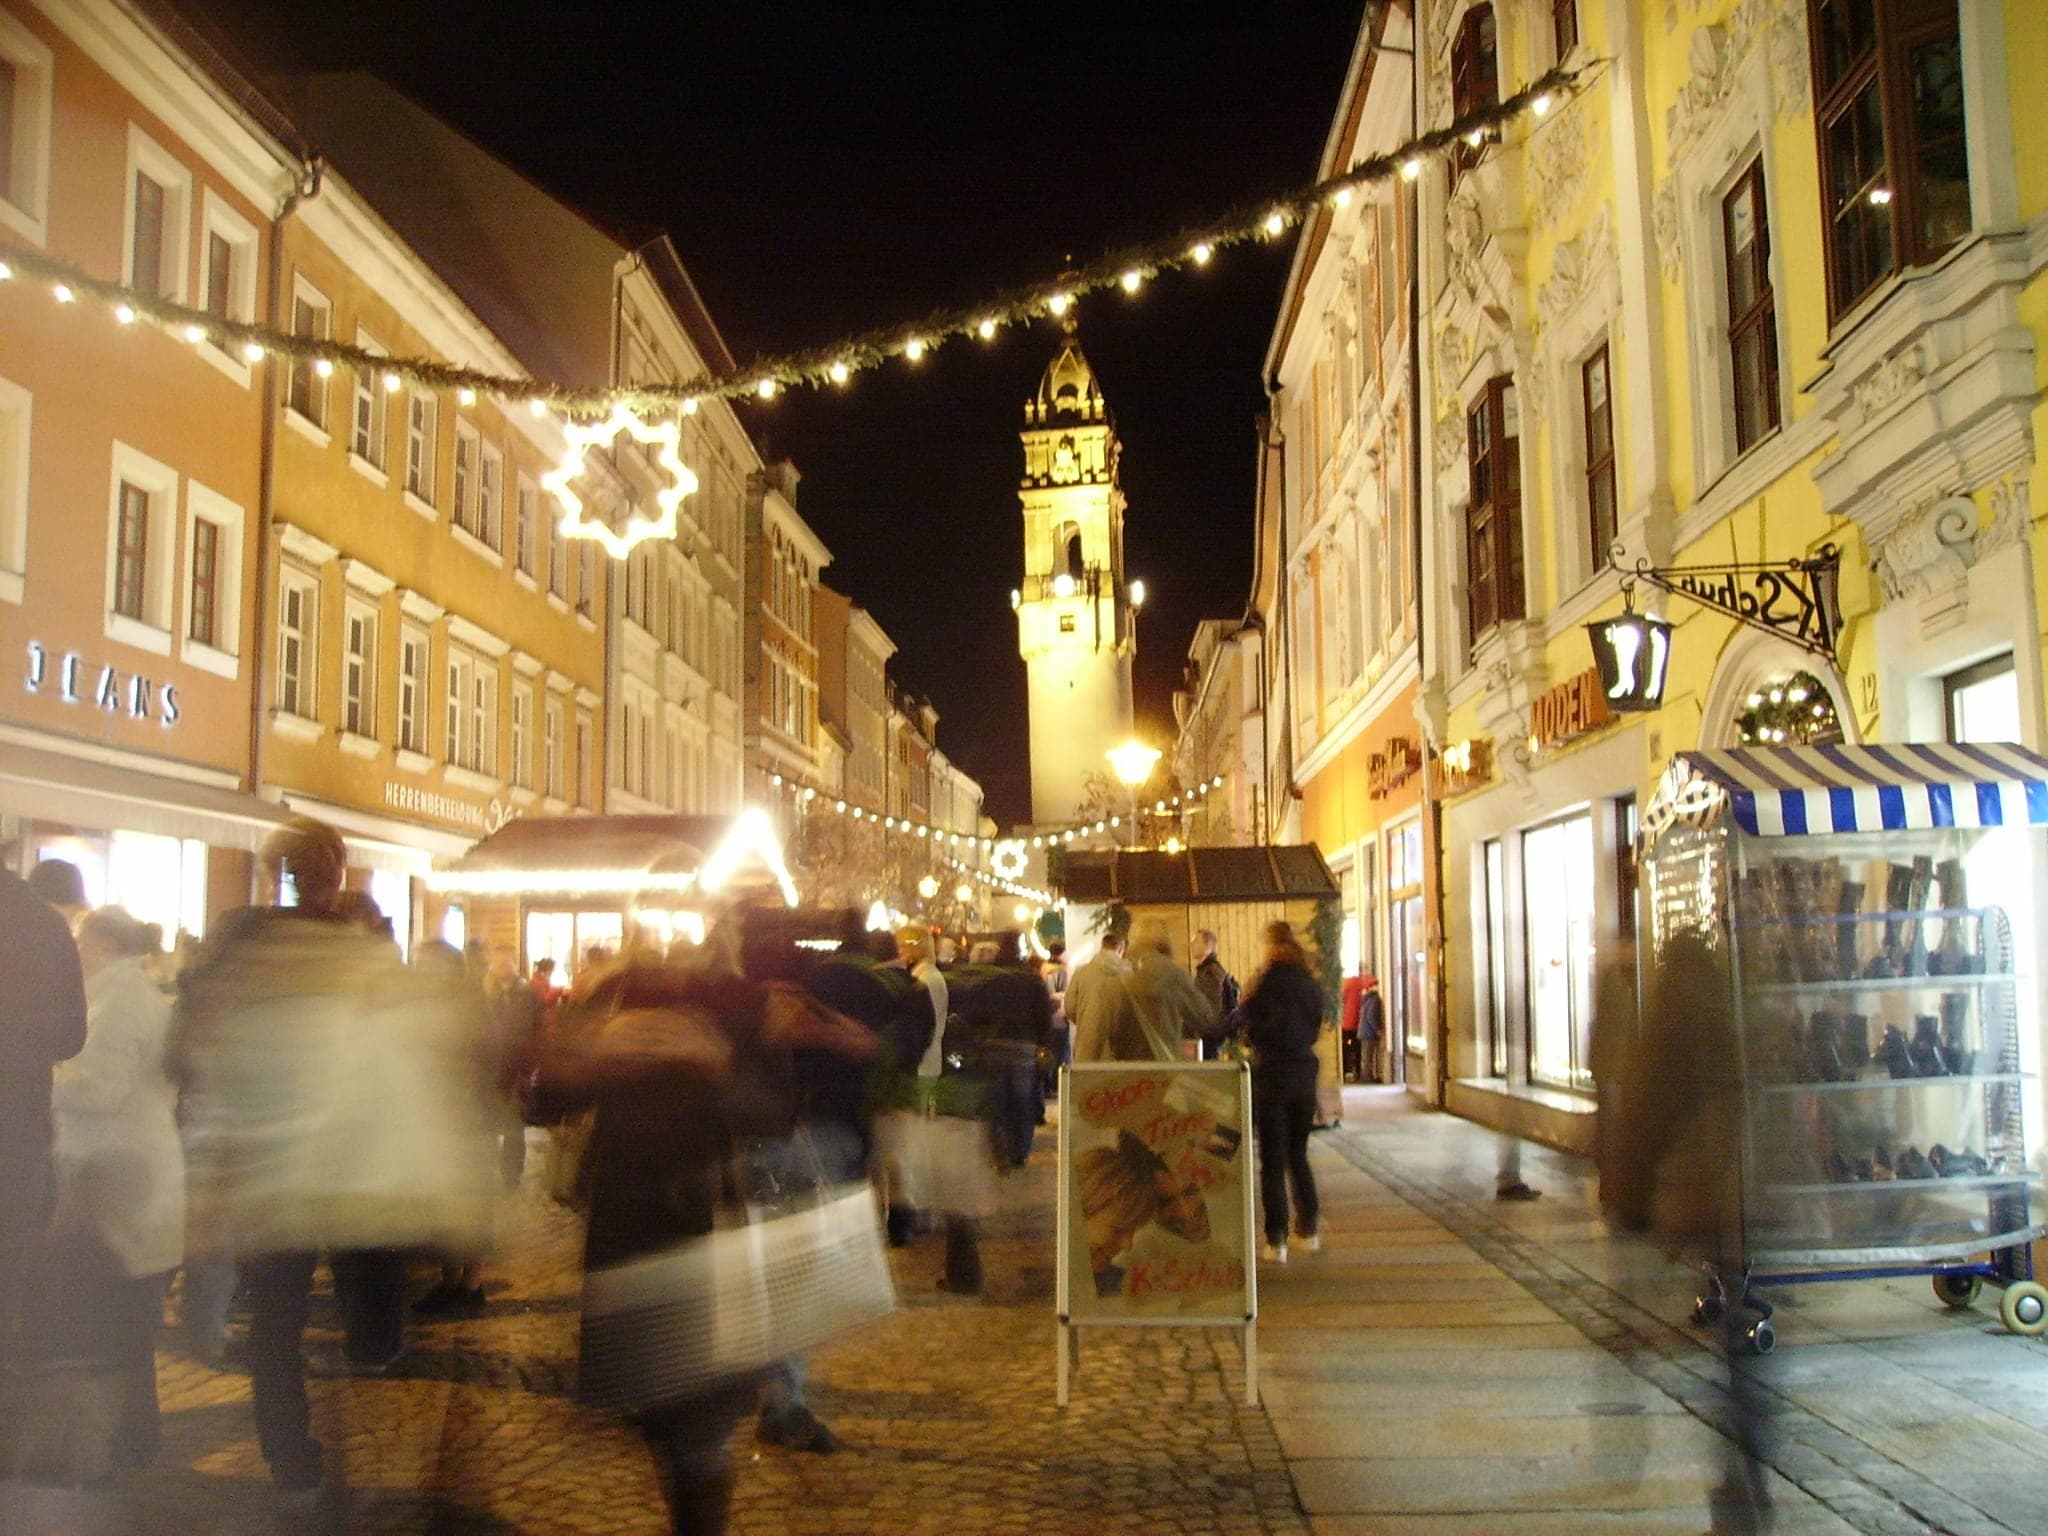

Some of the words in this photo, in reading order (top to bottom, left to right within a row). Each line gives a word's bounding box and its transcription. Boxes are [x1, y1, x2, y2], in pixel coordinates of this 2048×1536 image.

[25, 640, 182, 729] JEANS
[1529, 668, 1605, 750] MODEN
[1861, 672, 1879, 714] 12
[385, 781, 485, 828] HERRENBEKLEIDUNG
